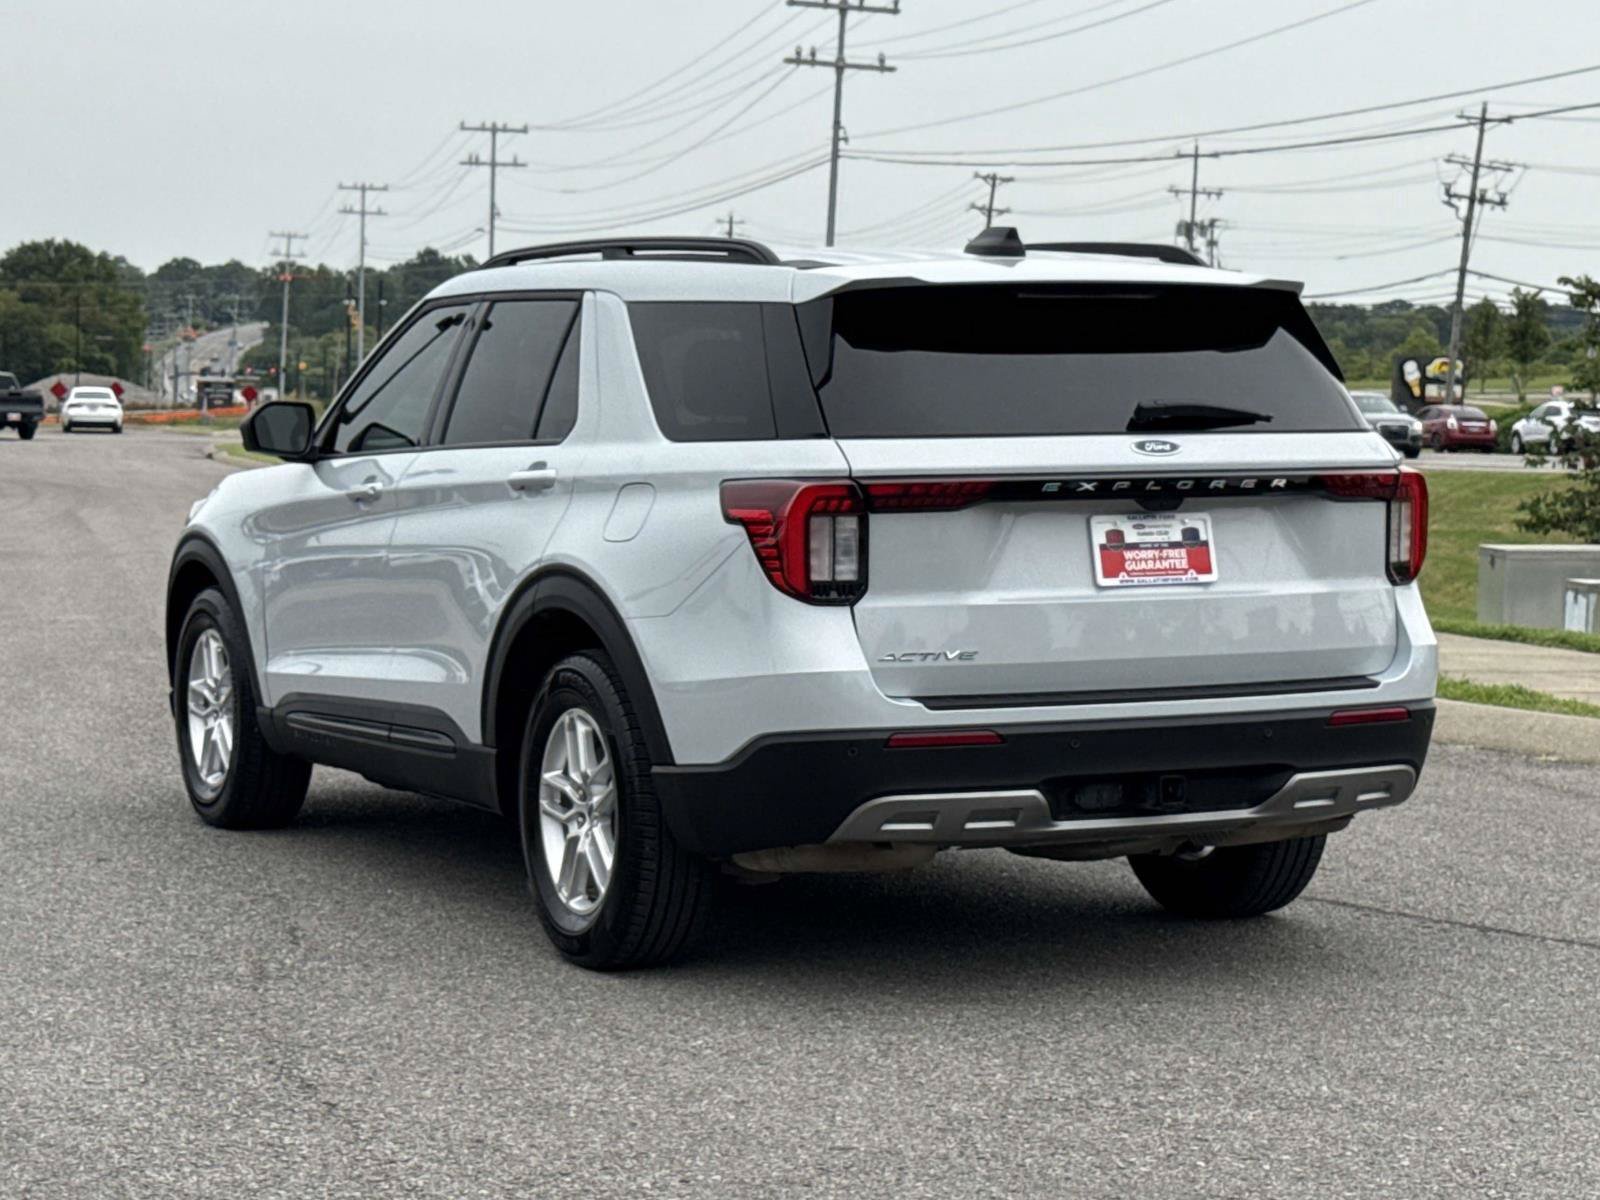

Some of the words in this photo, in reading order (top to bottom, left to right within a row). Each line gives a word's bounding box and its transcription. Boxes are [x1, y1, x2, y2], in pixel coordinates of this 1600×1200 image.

[1144, 442, 1171, 451] Ford
[1041, 478, 1287, 493] EXPLORER
[1123, 548, 1187, 560] WORRY-FREE
[1125, 558, 1189, 571] GUARANTEE
[878, 650, 979, 662] ACTIVE
